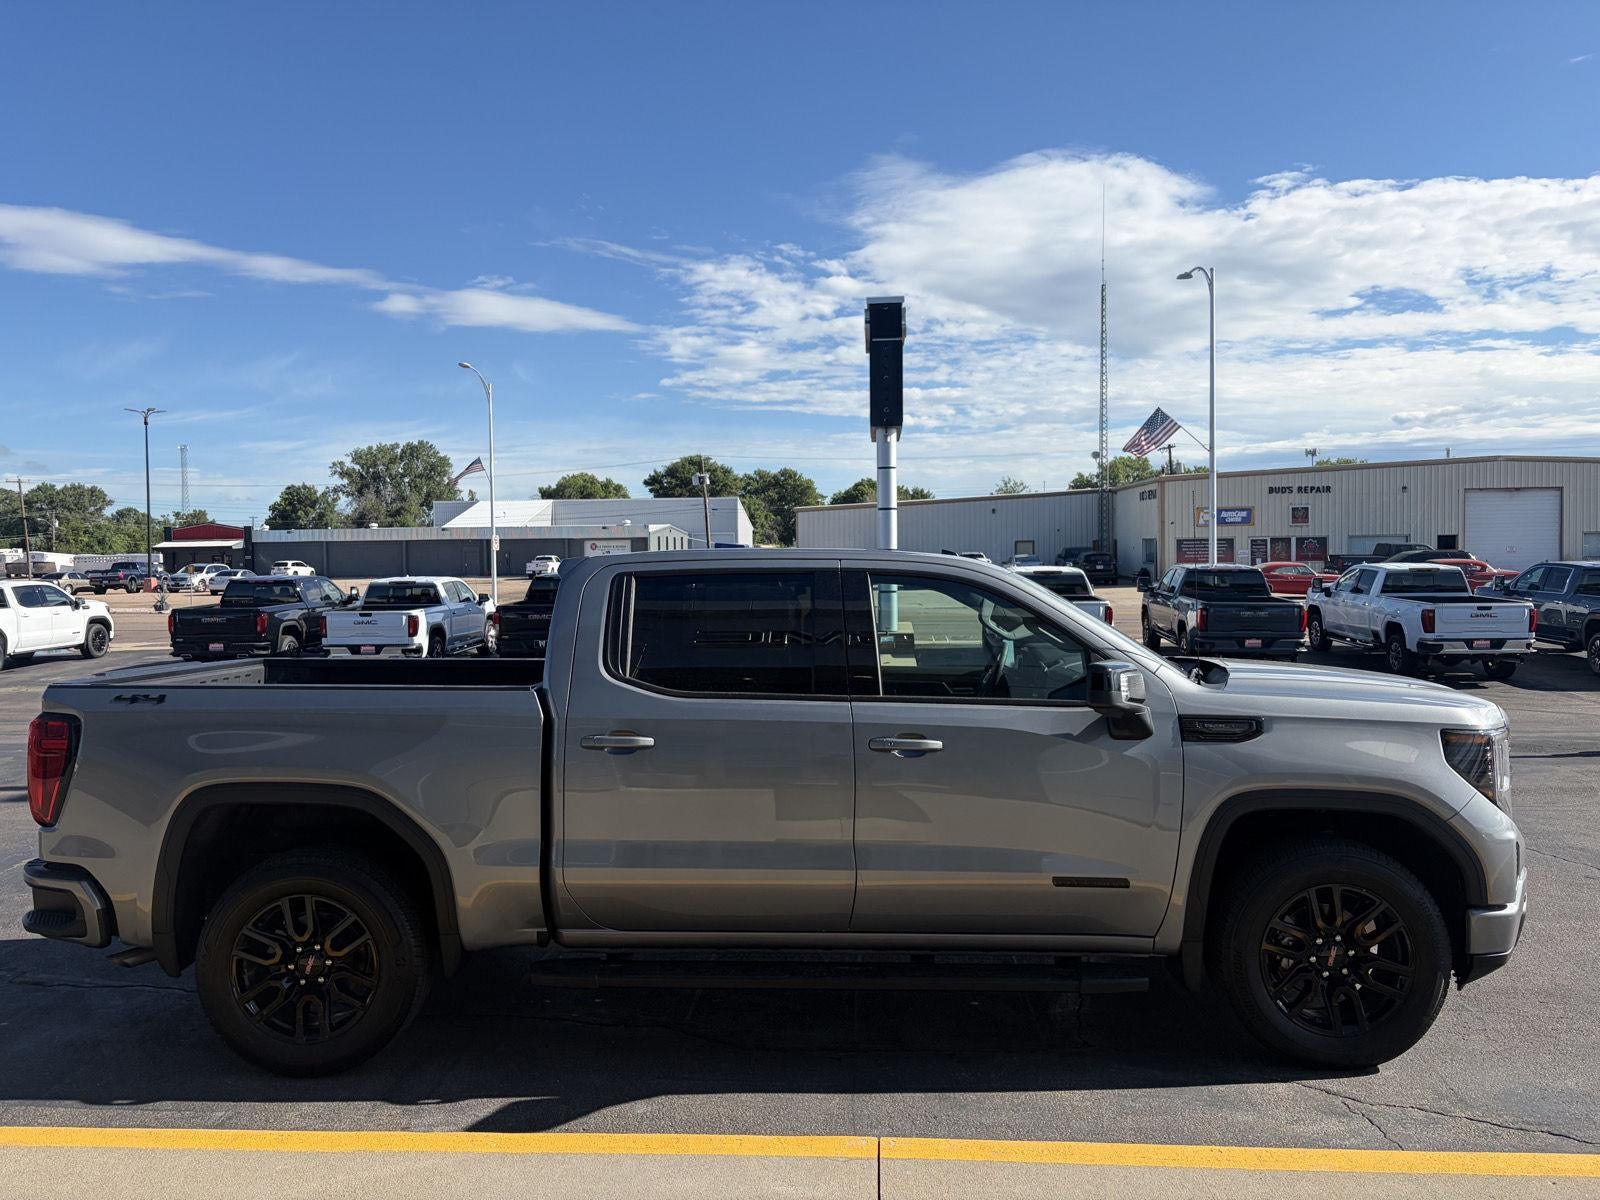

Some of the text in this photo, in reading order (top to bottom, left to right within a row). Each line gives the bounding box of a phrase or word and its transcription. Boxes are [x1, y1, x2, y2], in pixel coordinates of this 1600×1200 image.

[1268, 485, 1332, 495] BUD'S REPAIR
[304, 954, 316, 975] GMC
[1327, 945, 1338, 967] GMC
